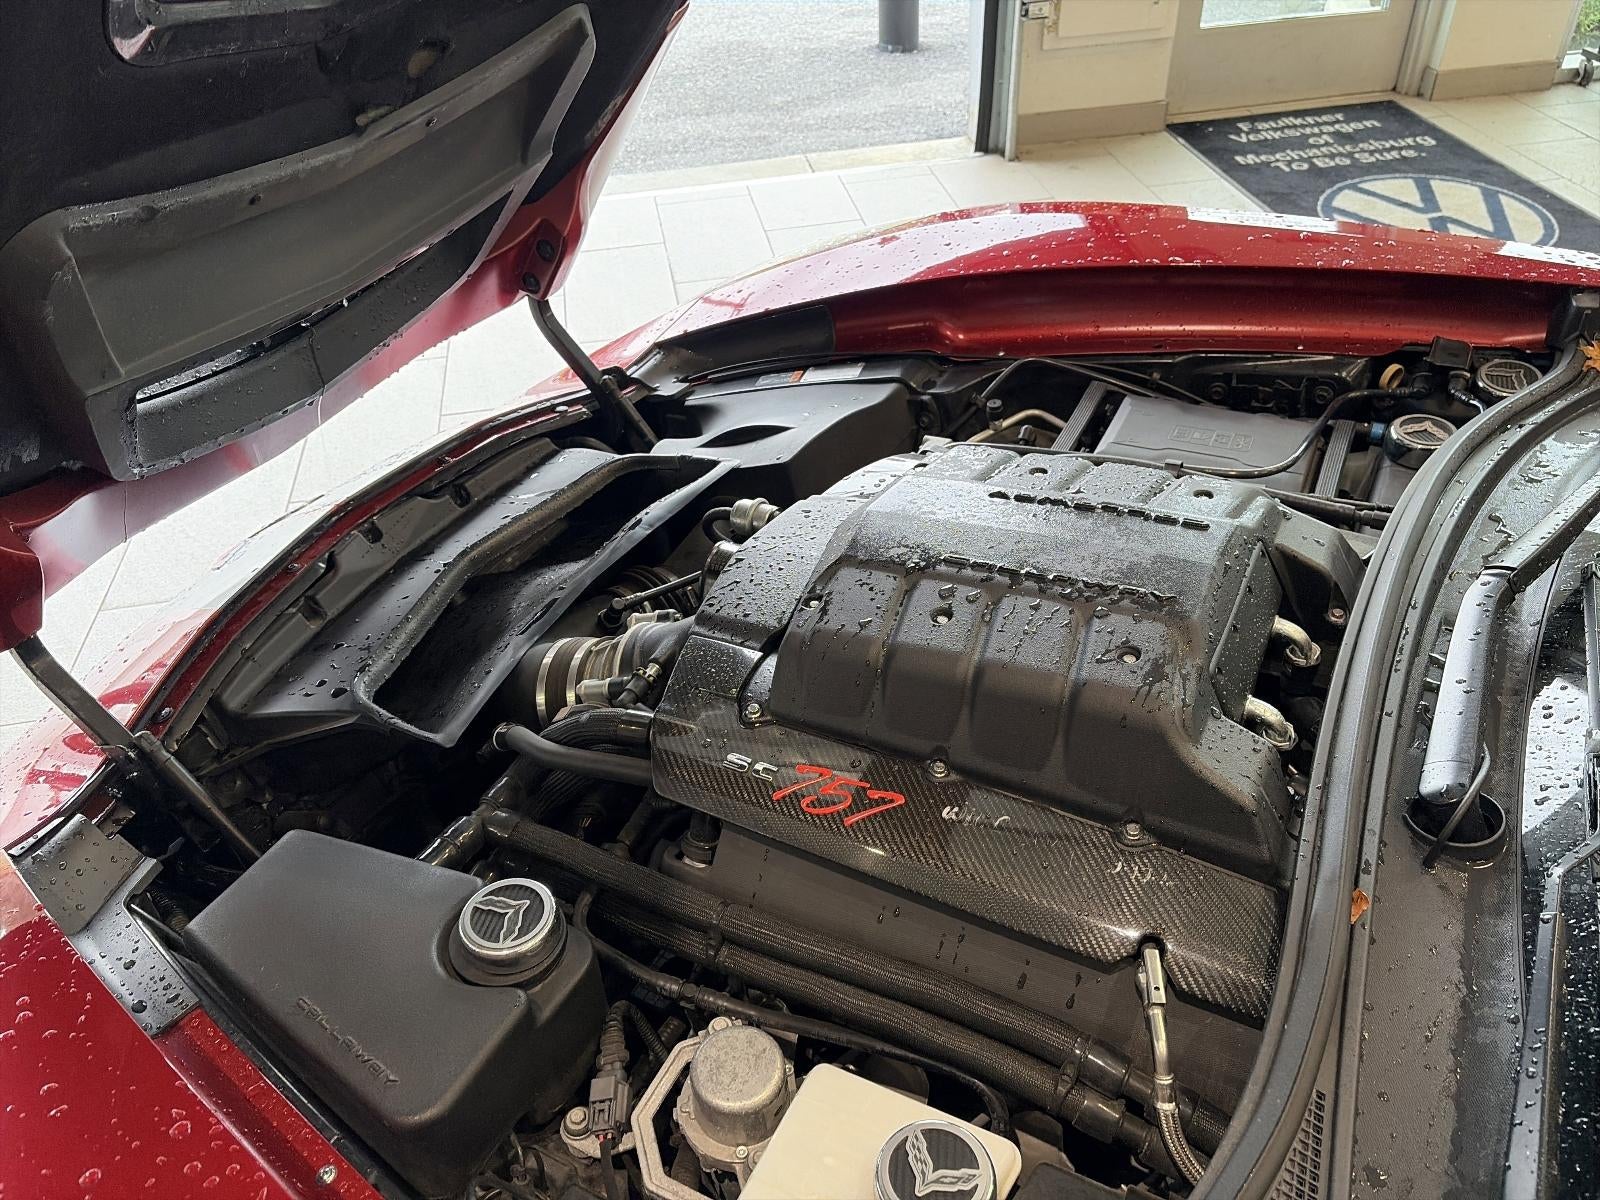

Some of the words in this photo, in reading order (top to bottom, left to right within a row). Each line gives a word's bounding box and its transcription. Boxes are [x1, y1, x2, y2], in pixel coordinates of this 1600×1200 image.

[1228, 119, 1382, 144] Volkswagen
[1236, 112, 1345, 132] Faulkner
[1234, 135, 1437, 165] Mechanicsburg
[1308, 134, 1335, 145] of
[1271, 160, 1309, 172] To
[1312, 156, 1350, 168] Be
[1353, 149, 1426, 163] Sure.
[772, 764, 905, 827] 757
